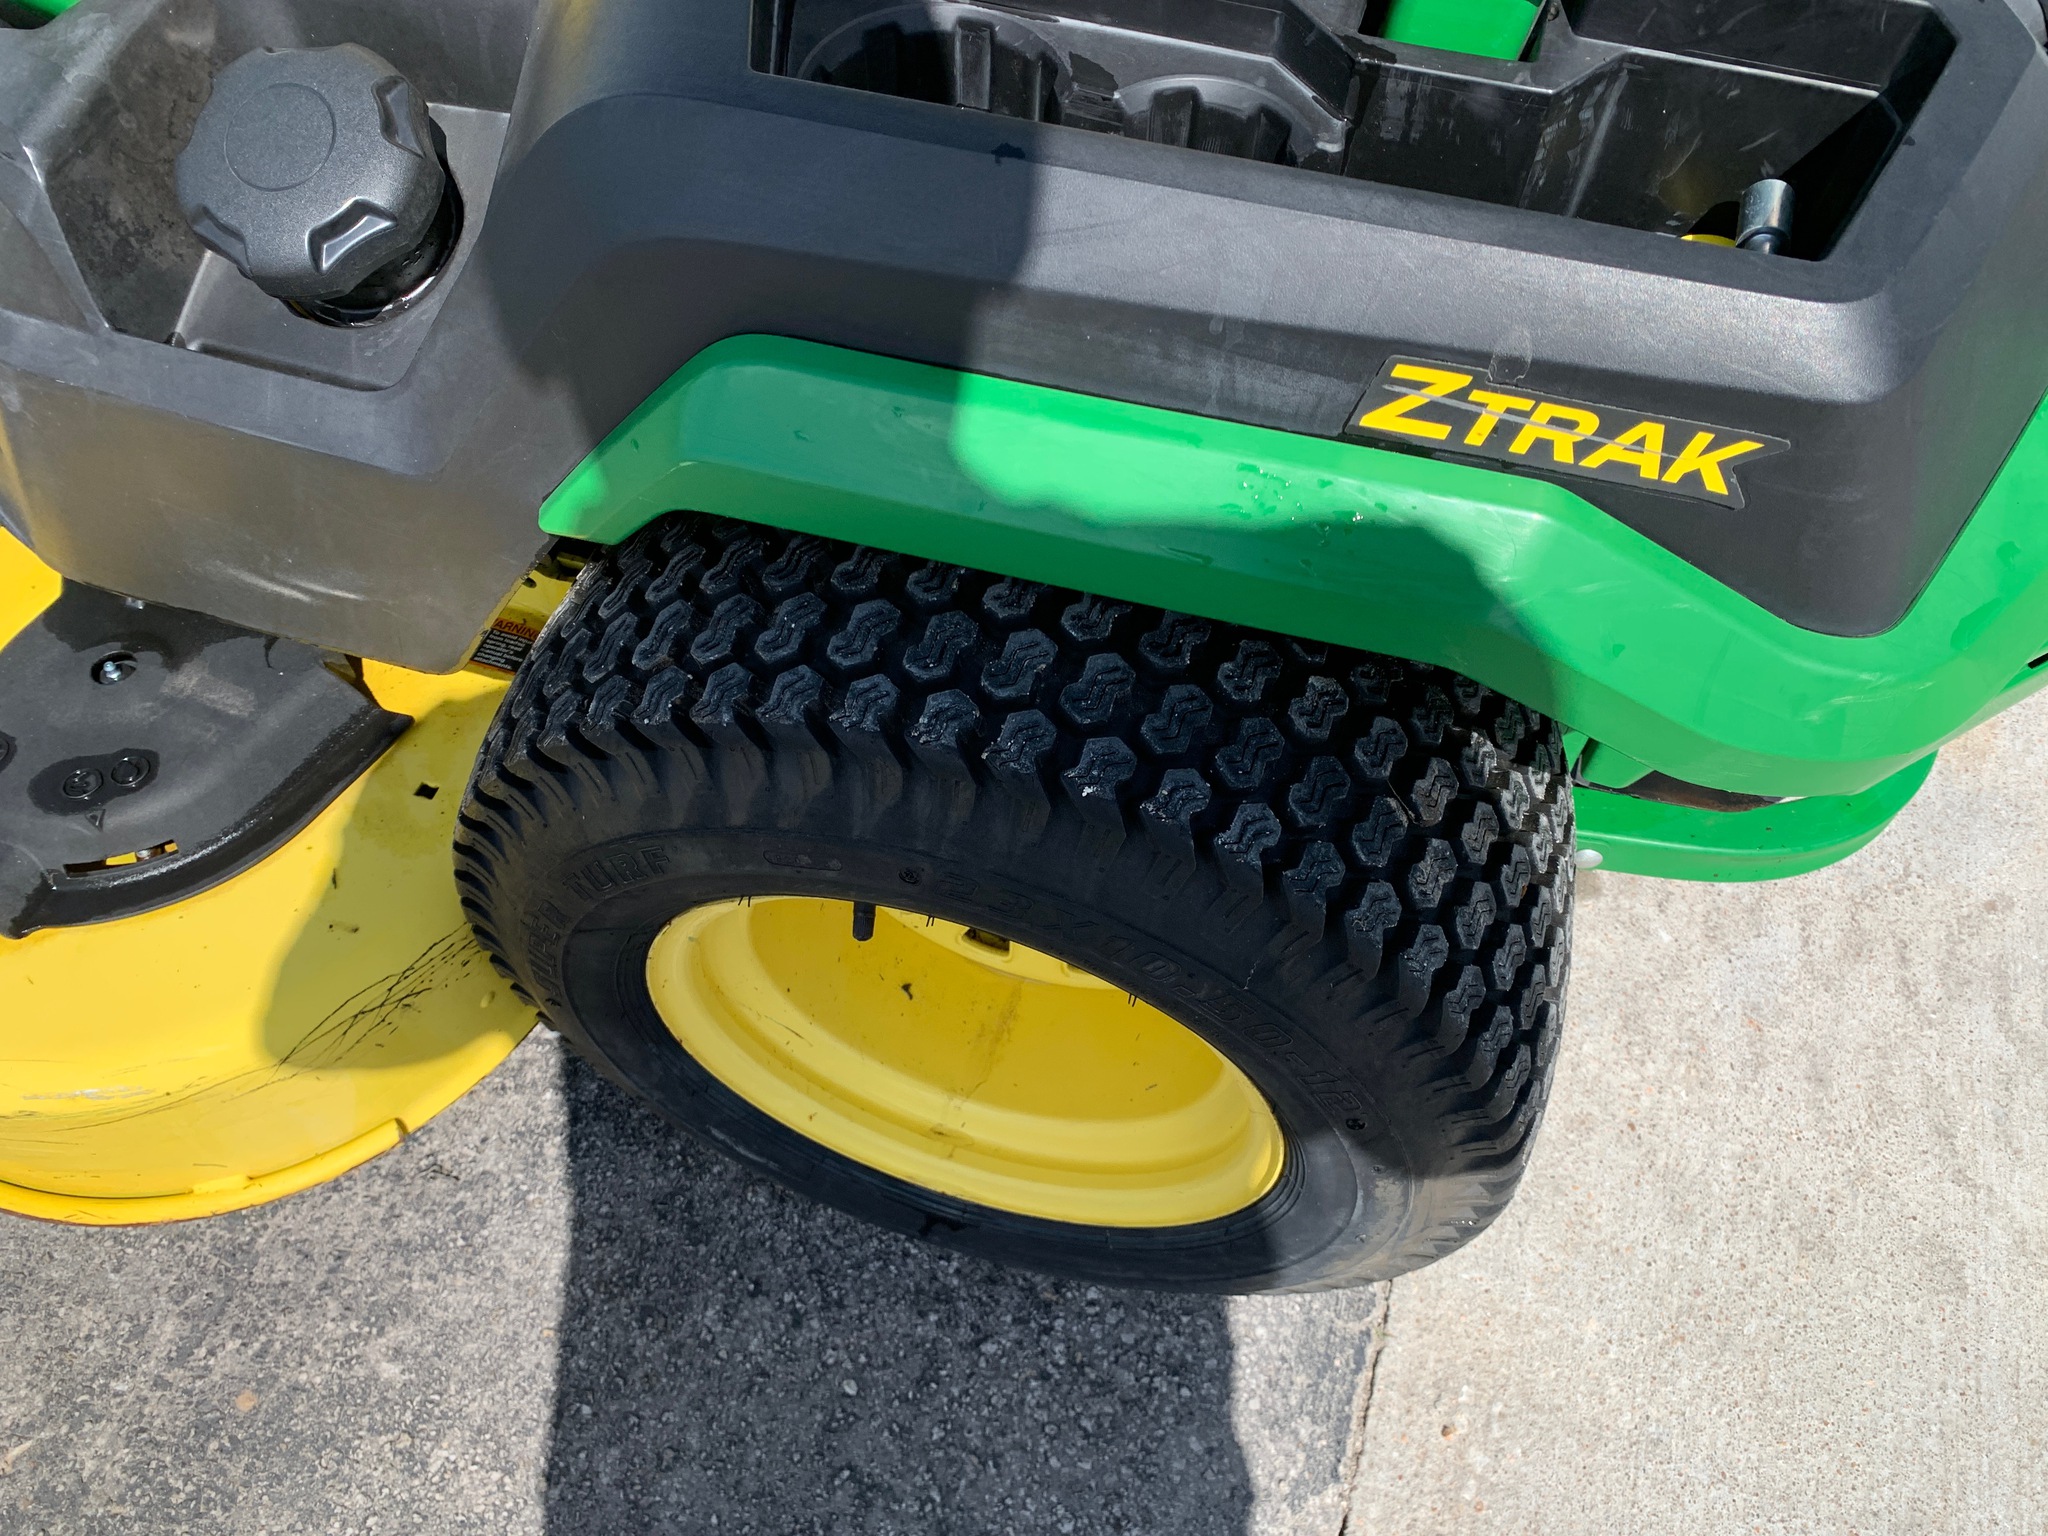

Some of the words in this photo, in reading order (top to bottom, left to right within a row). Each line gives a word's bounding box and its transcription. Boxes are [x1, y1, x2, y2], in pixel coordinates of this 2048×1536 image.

[1359, 363, 1765, 496] ZTRAK
[494, 620, 539, 640] ARNIN
[520, 899, 572, 997] SUPER
[561, 845, 672, 901] TURF
